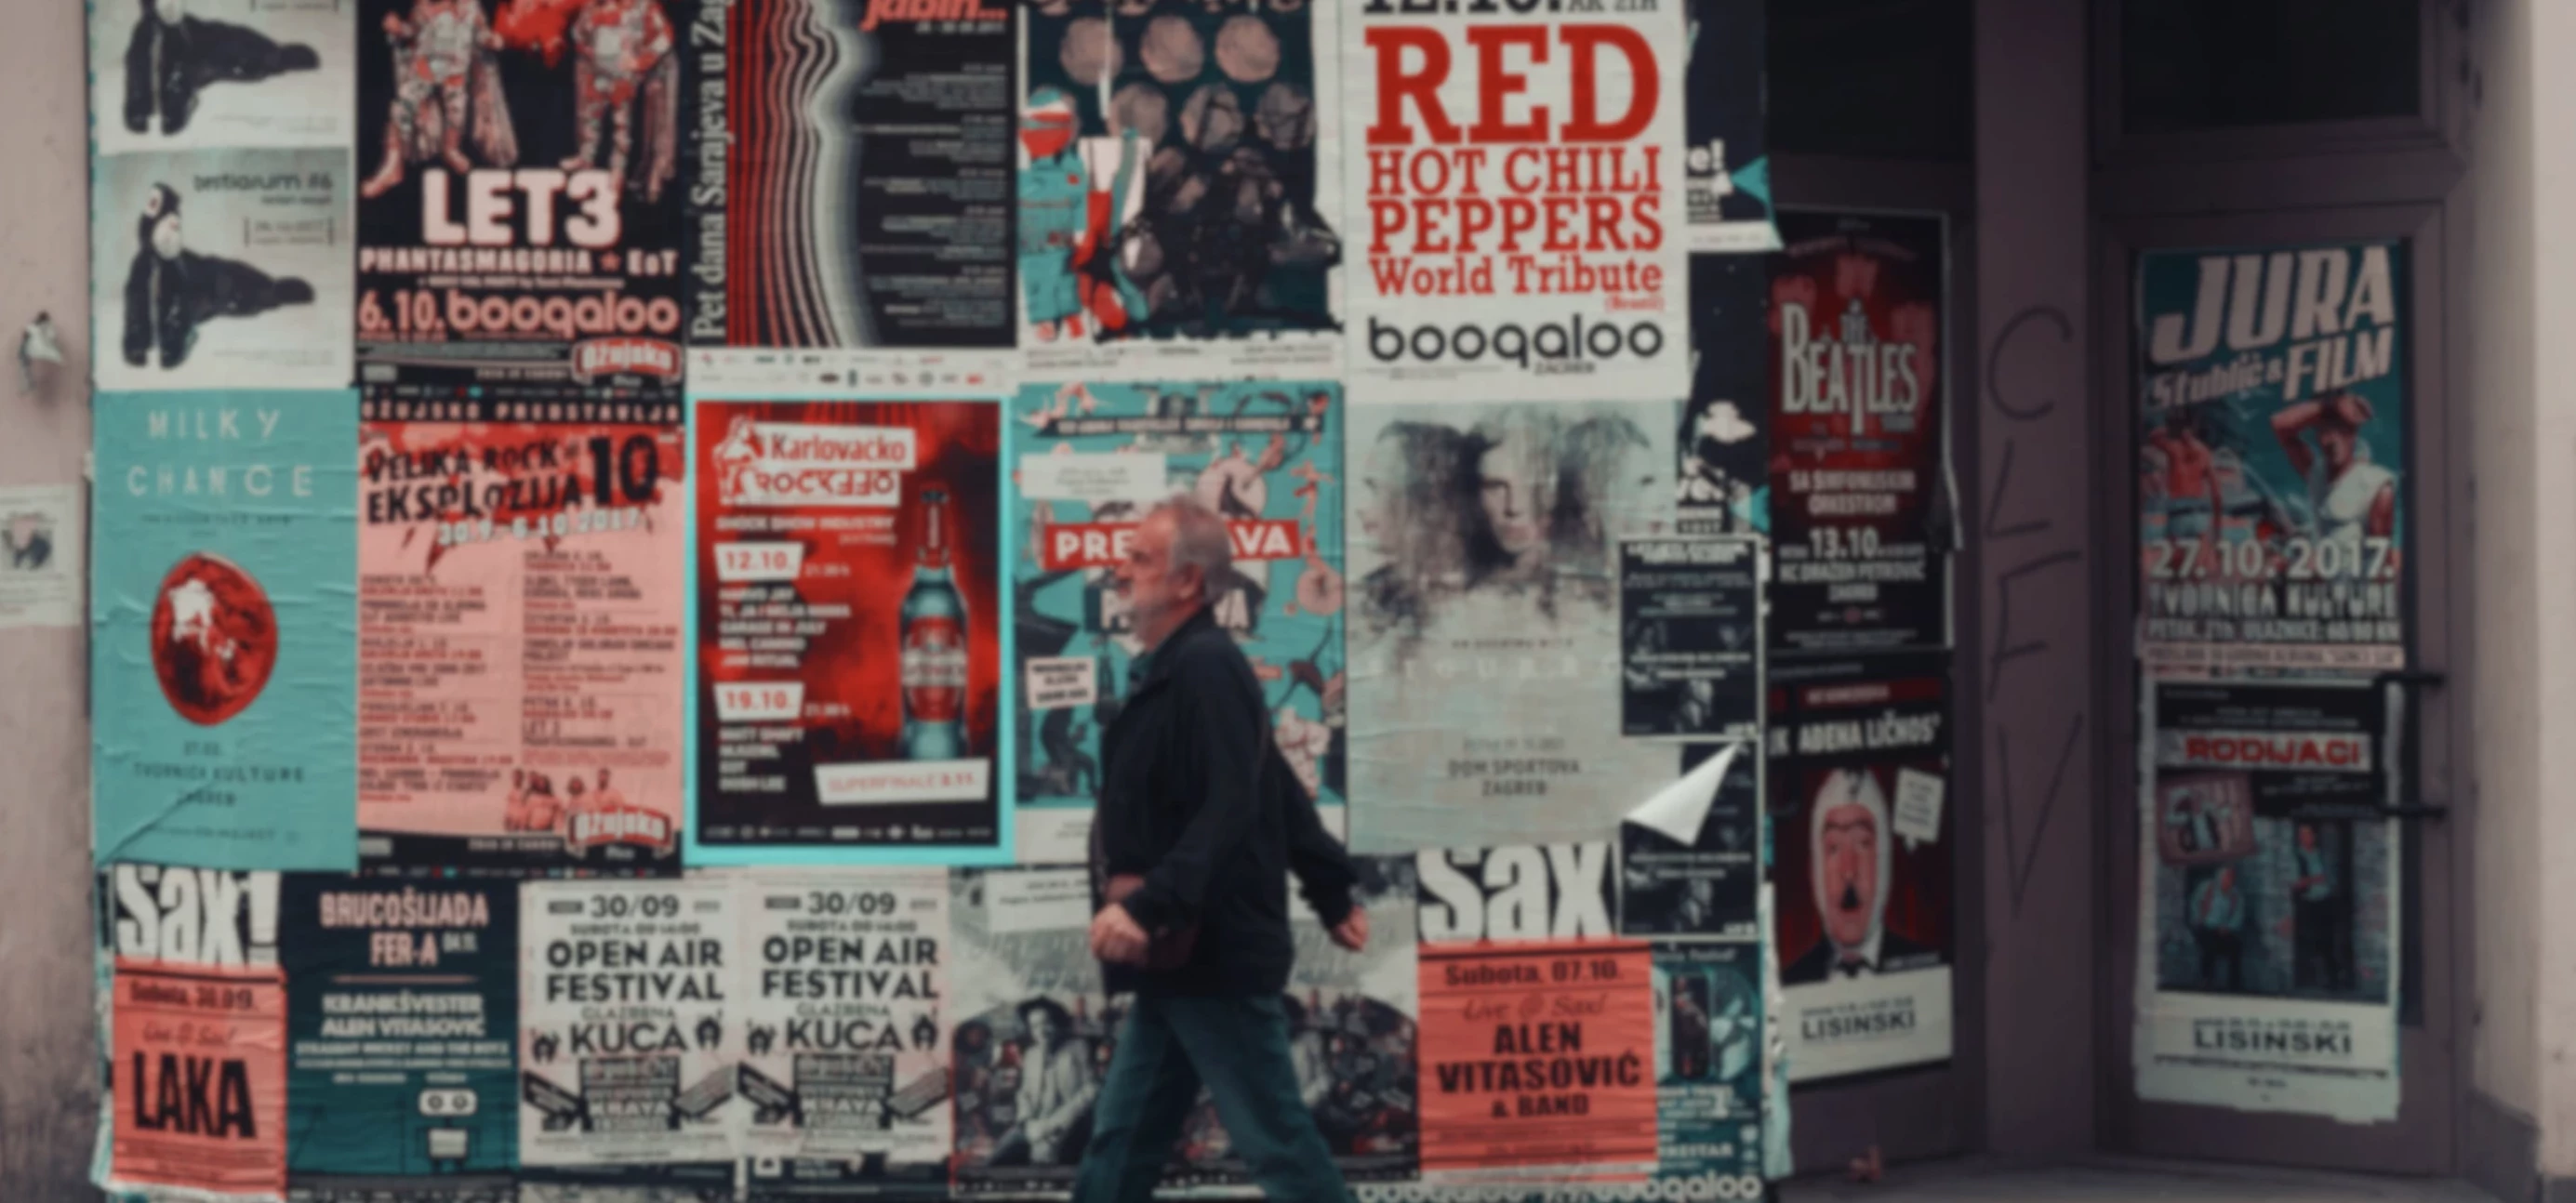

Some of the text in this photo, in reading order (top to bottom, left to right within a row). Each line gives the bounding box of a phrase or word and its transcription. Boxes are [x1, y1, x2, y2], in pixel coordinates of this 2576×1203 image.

[1363, 24, 1660, 145] RED
[690, 79, 736, 207] Sarajeva
[1367, 146, 1662, 195] HOT CHILI
[423, 169, 621, 246] LET3
[1368, 196, 1663, 254] PEPPERS
[359, 248, 592, 273] PHANTASMAGORIA
[690, 212, 727, 286] dana
[1369, 254, 1664, 297] World Tribute
[2149, 245, 2395, 365] JURA
[2283, 326, 2394, 402] FILM
[148, 408, 281, 441] MILKY
[126, 464, 313, 497] CHANCE
[2287, 536, 2395, 579] 2017.
[590, 894, 681, 919] 30/09
[806, 891, 897, 916] 30/09
[546, 939, 724, 969] OPEN AIR
[762, 935, 939, 966] OPEN AIR
[546, 972, 724, 1003] FESTIVAL
[762, 969, 940, 1000] FESTIVAL
[1444, 959, 1544, 987] Subota,
[1494, 1024, 1583, 1056] ALEN
[1800, 1006, 1917, 1041] LISINSKI
[2194, 1027, 2353, 1056] LISINSKI
[1436, 1050, 1642, 1093] VITASOVIĆ
[132, 1049, 258, 1140] LAKA
[1517, 1093, 1590, 1117] BAND
